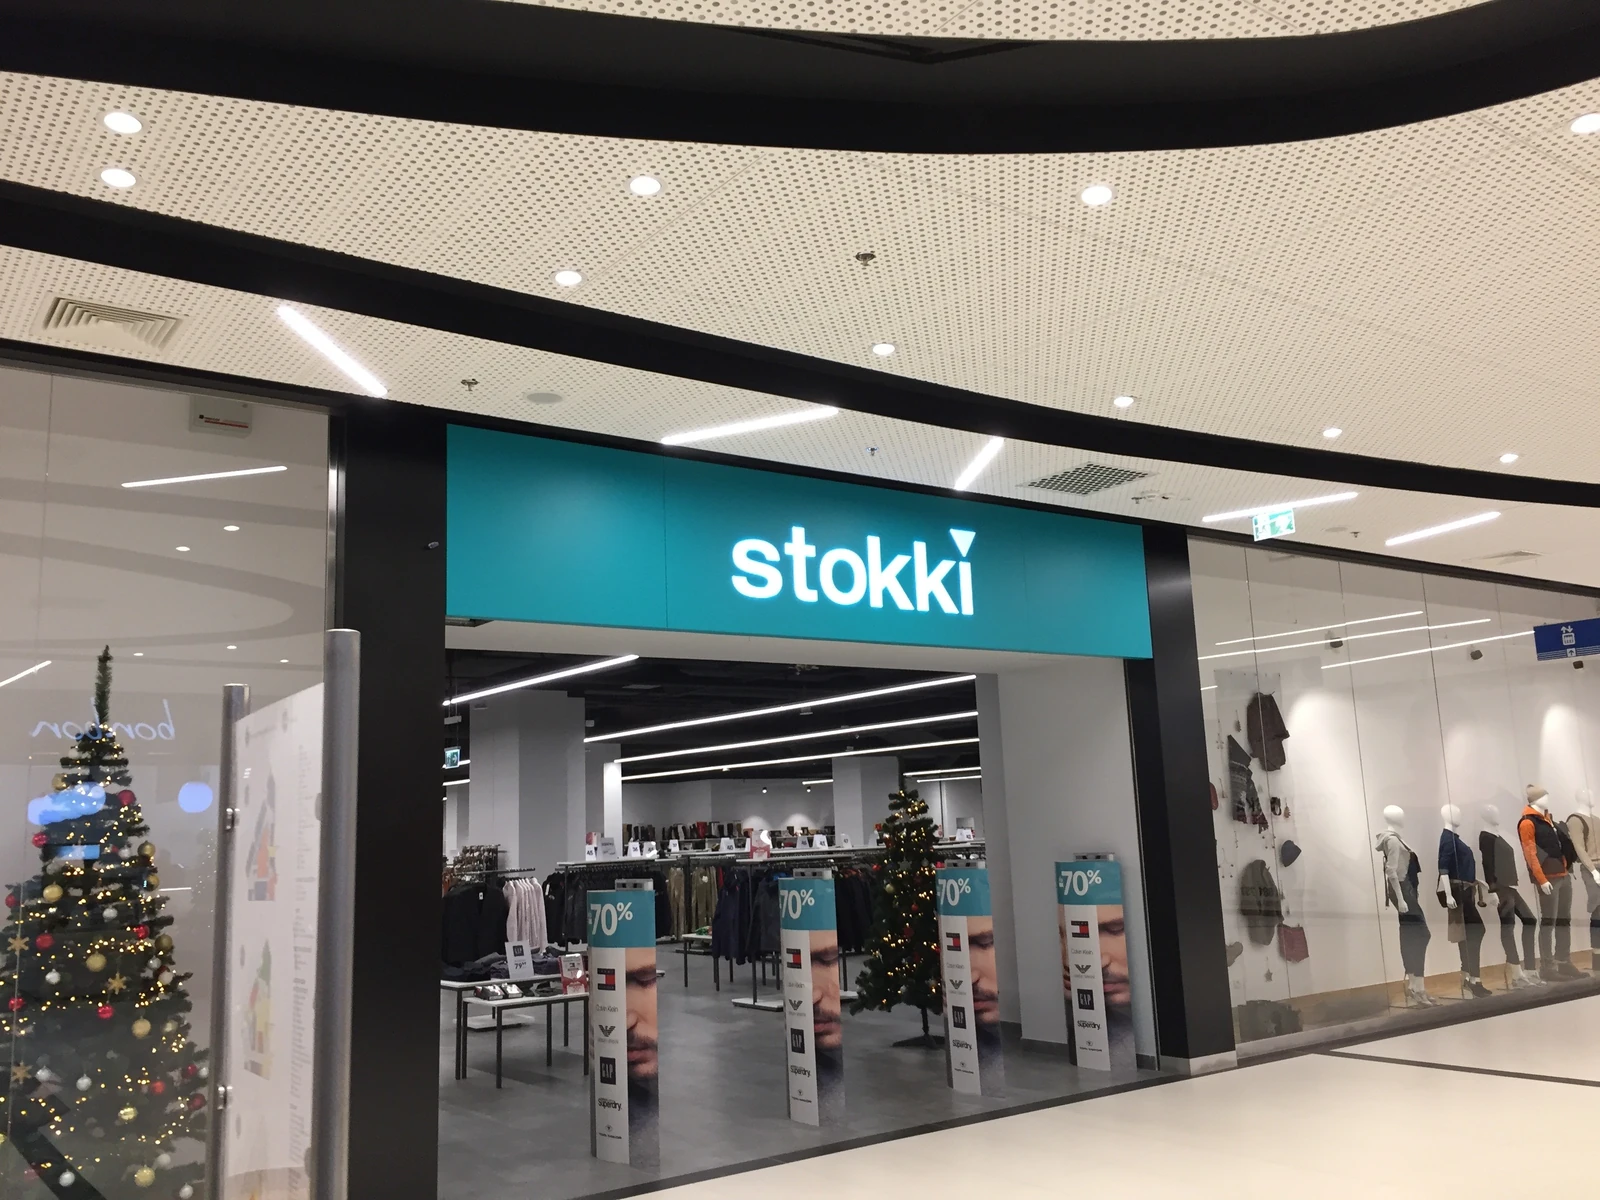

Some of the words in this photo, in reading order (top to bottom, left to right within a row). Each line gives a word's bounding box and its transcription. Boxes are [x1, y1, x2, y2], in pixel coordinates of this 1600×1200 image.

[731, 526, 976, 615] stokki
[1080, 993, 1091, 1006] GAP
[601, 1062, 614, 1079] GAP
